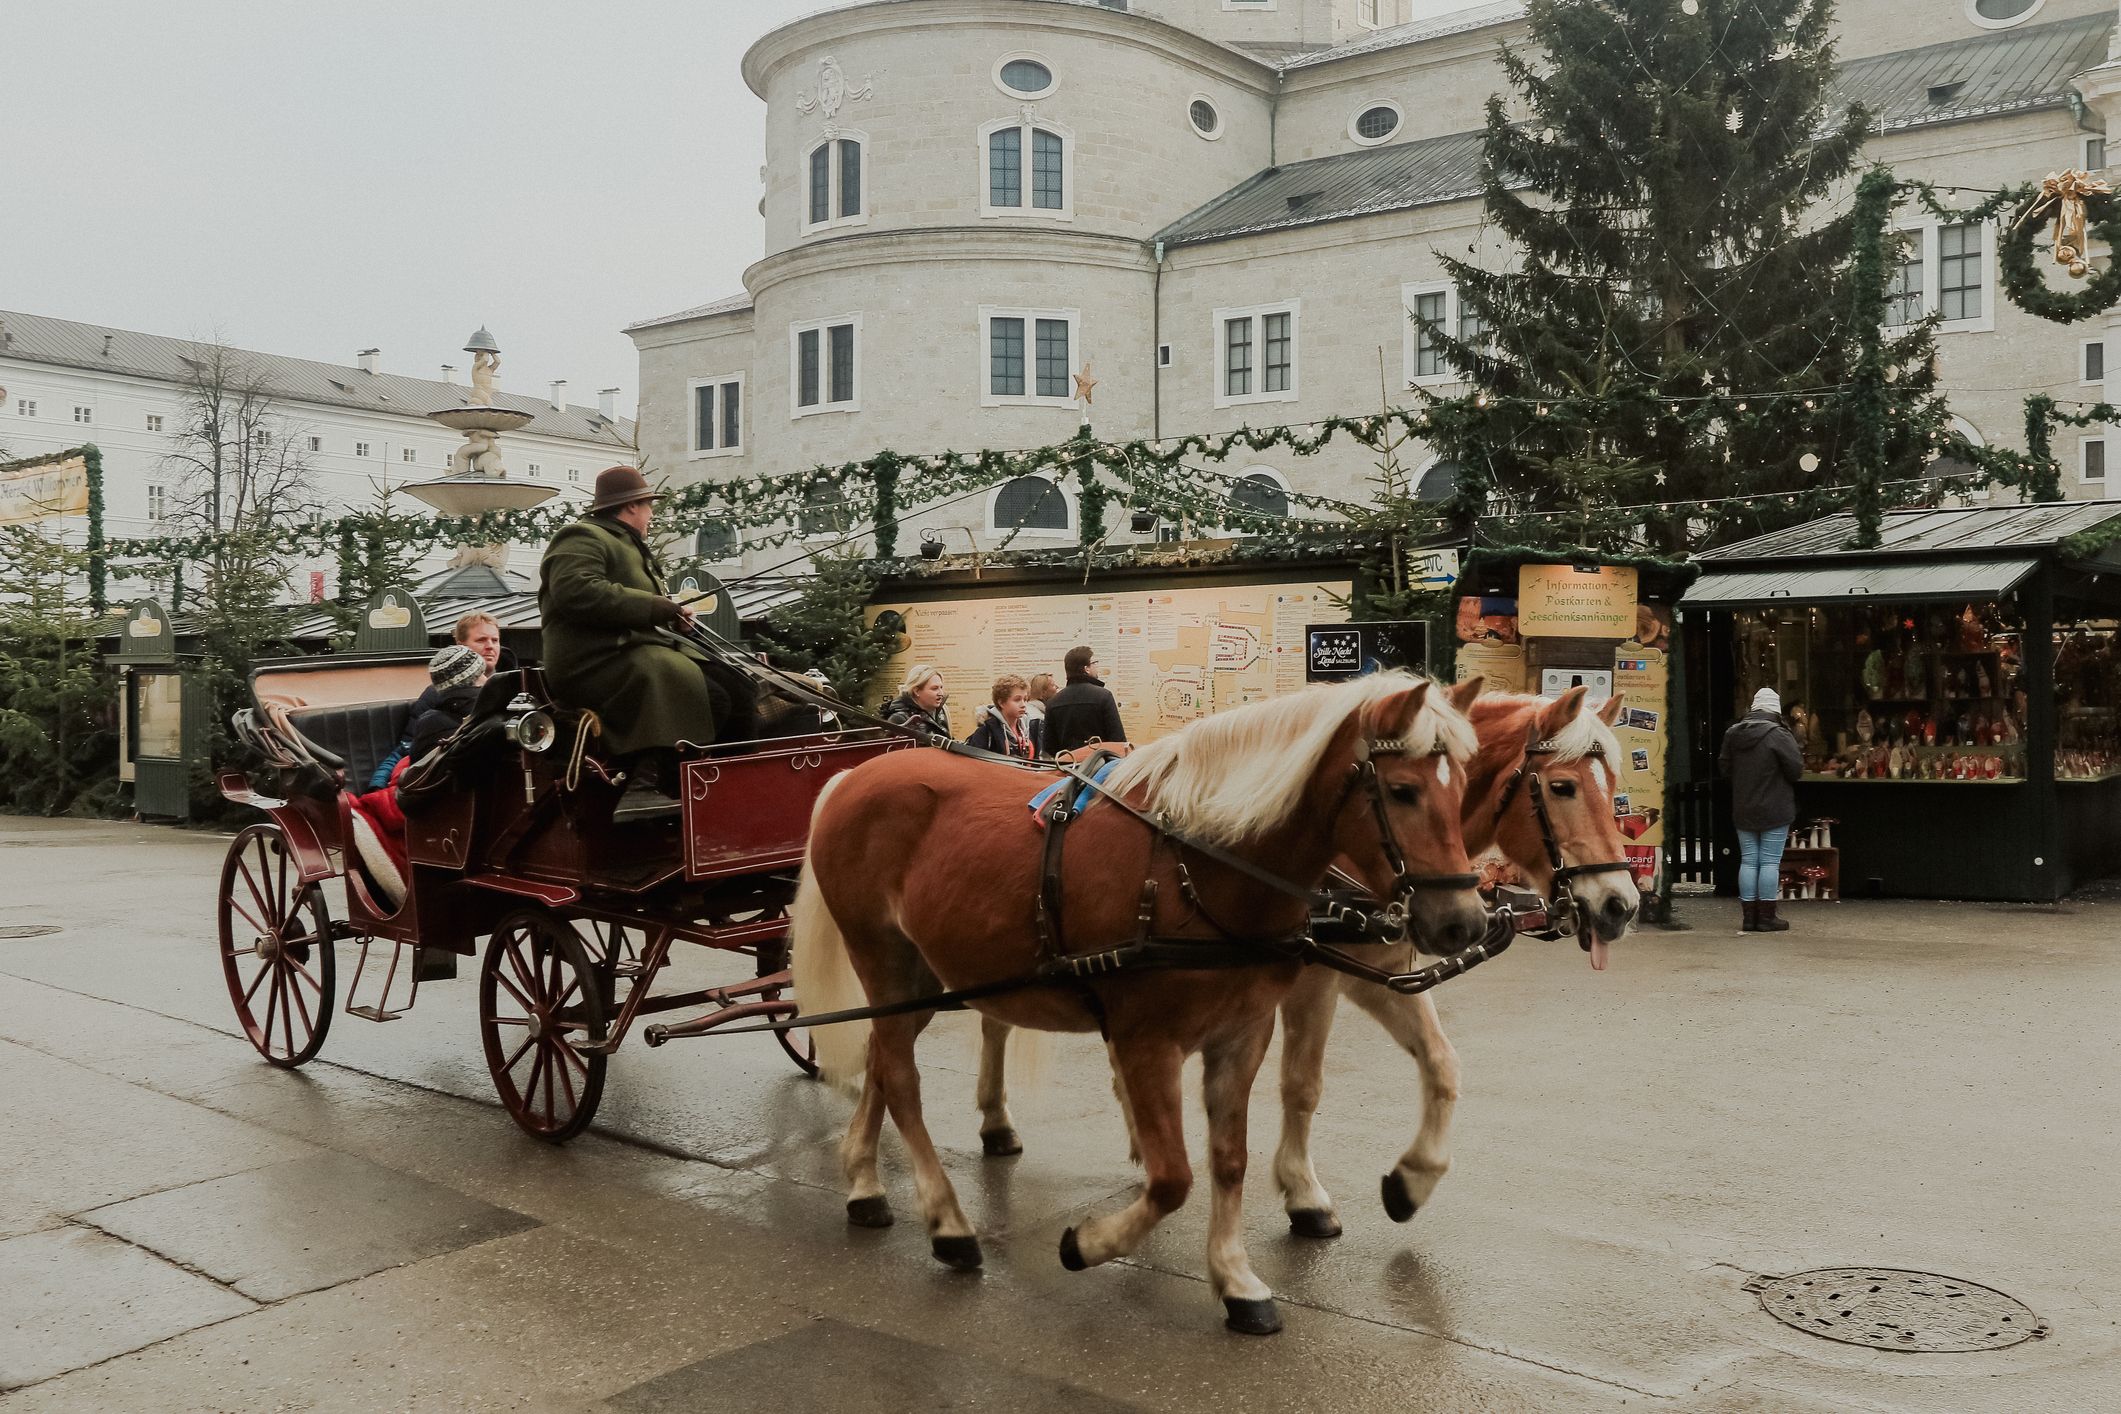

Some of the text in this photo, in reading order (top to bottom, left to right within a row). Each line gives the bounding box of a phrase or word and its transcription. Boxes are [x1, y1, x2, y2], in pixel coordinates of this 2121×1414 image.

[1424, 554, 1443, 572] WC
[1545, 596, 1612, 606] Postkarten &
[1528, 611, 1628, 626] Geschenkanhänger
[1314, 647, 1352, 658] Stille Nacht
[1318, 656, 1336, 667] Land
[1625, 855, 1653, 864] ocard
